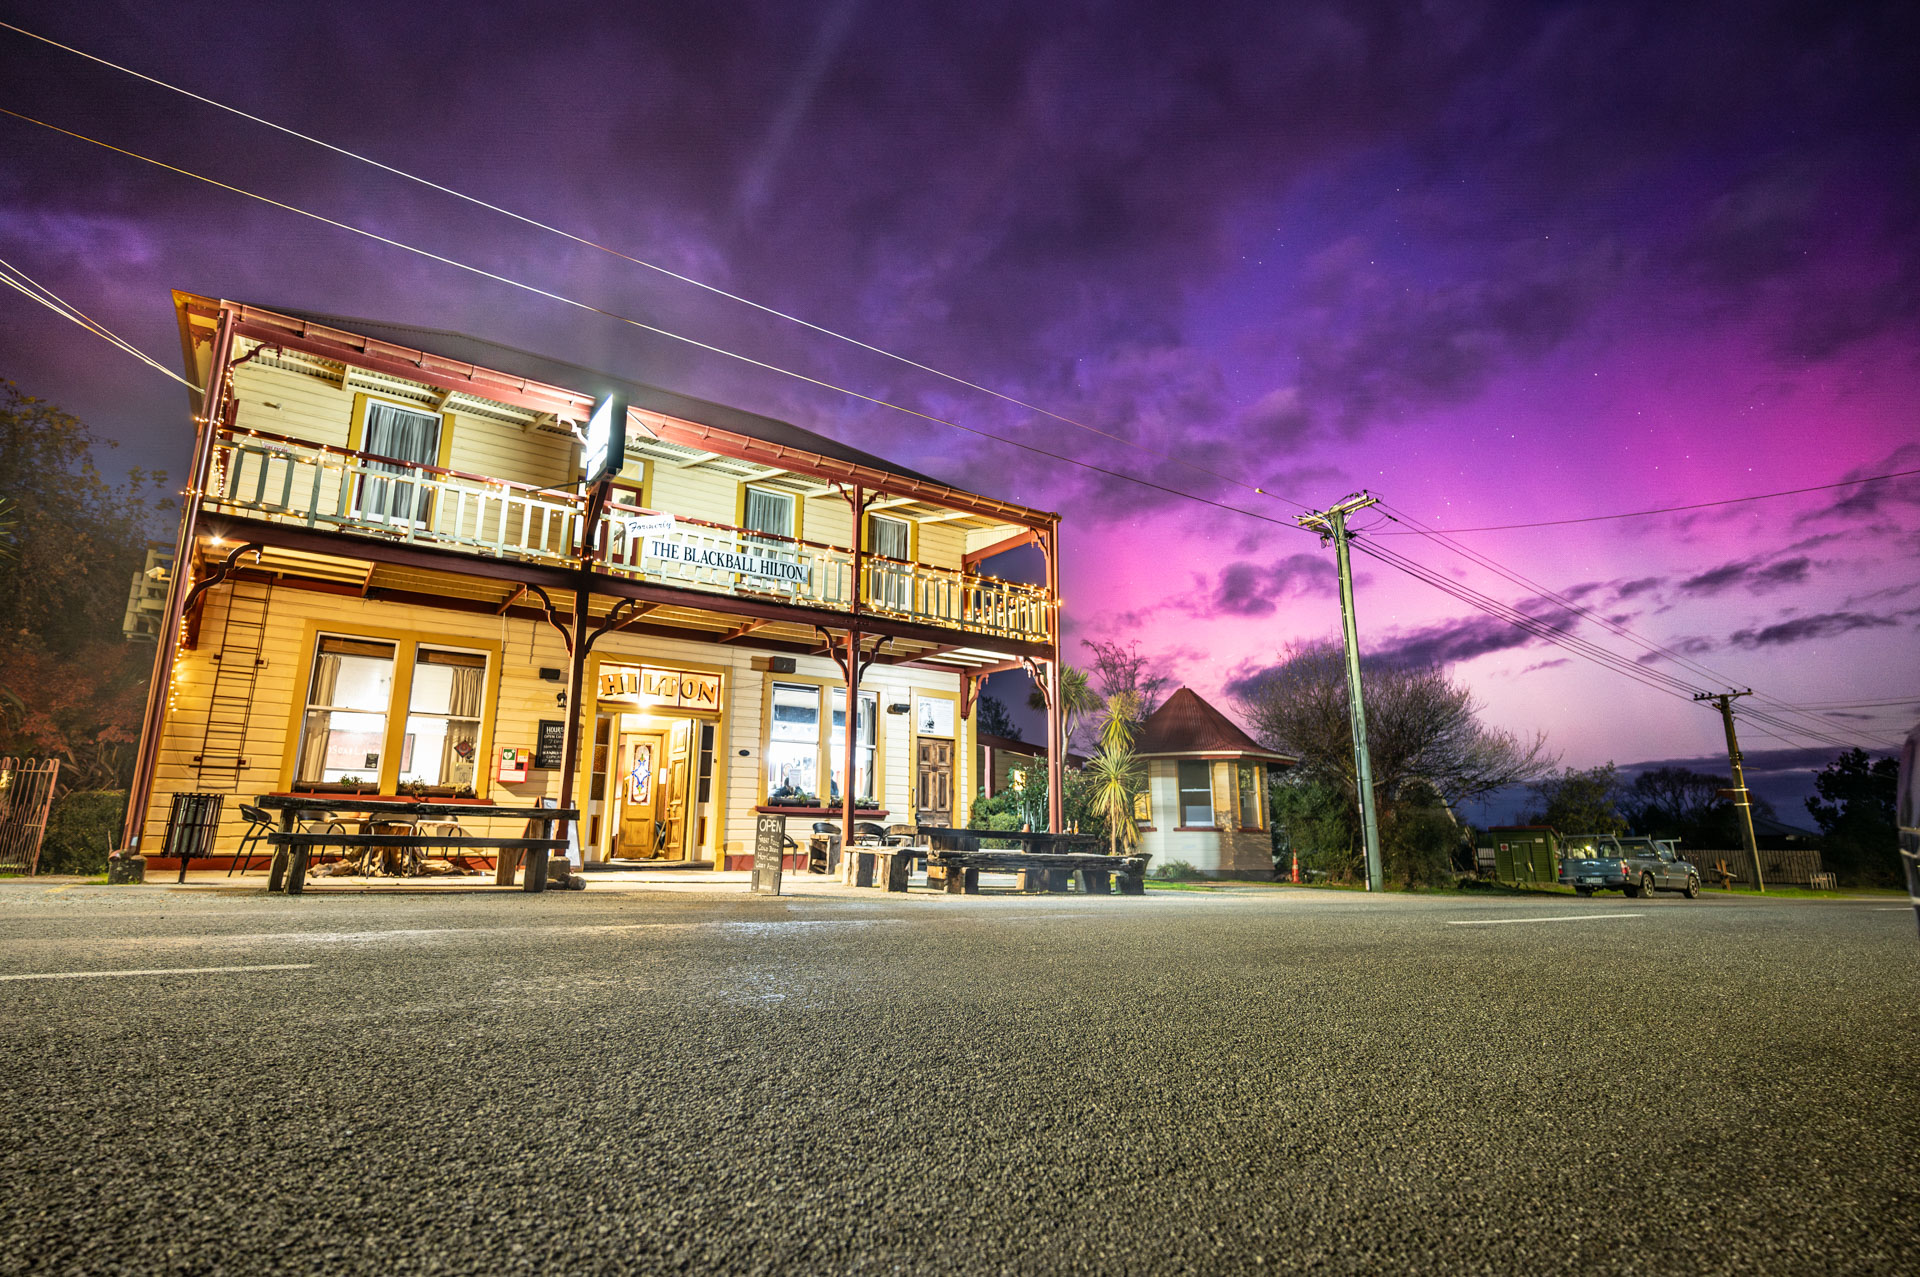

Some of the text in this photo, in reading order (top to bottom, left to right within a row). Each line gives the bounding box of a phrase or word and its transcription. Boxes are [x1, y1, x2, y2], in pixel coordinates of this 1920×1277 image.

[652, 541, 804, 581] THE BLACKBALL HILTON
[600, 673, 718, 704] HILTON
[546, 726, 564, 734] HOURS
[759, 819, 782, 833] OPEN
